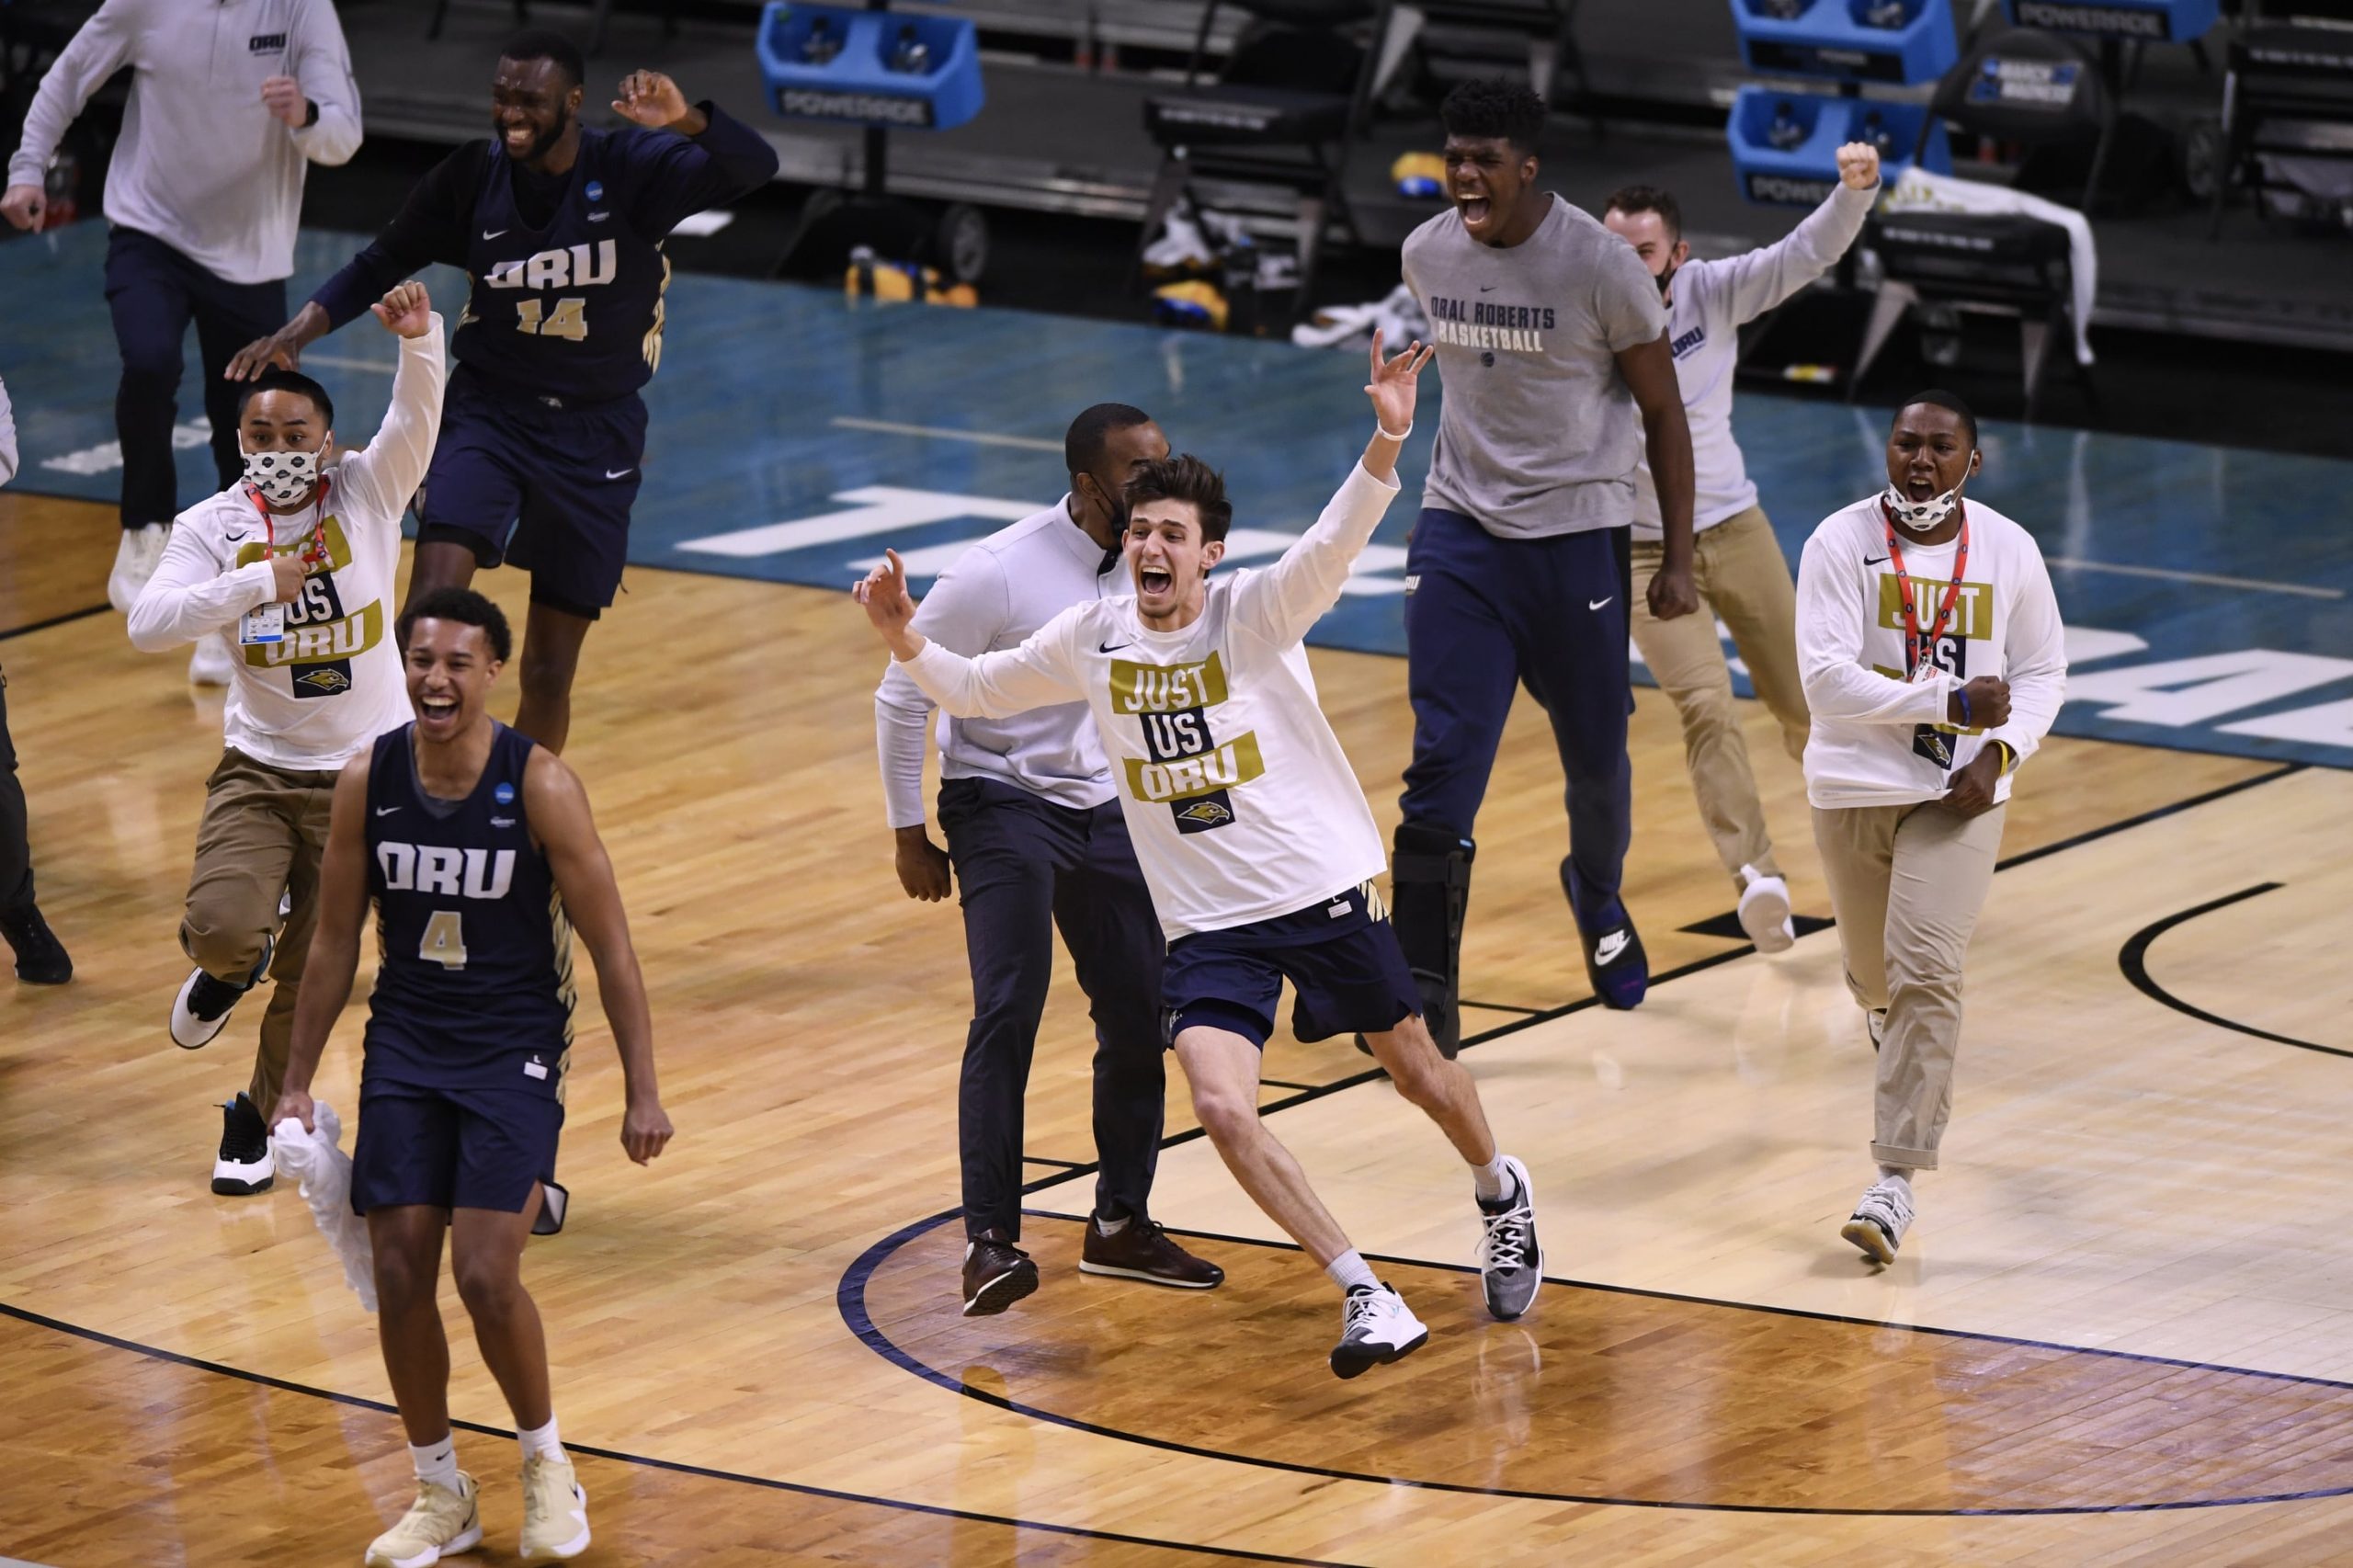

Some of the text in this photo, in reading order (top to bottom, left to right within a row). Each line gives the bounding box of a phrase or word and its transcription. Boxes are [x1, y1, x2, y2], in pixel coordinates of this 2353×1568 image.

[249, 33, 286, 51] ORU
[483, 239, 617, 290] ORU
[516, 297, 588, 341] 14
[1431, 296, 1555, 330] ORAL ROBERTS
[1438, 321, 1544, 352] BASKETBALL
[266, 611, 365, 665] ORU
[1124, 664, 1209, 711] JUST
[1149, 712, 1203, 758] US
[1141, 743, 1238, 800] ORU
[377, 840, 517, 899] ORU
[419, 910, 467, 970] 4
[1598, 928, 1625, 954] NIKE
